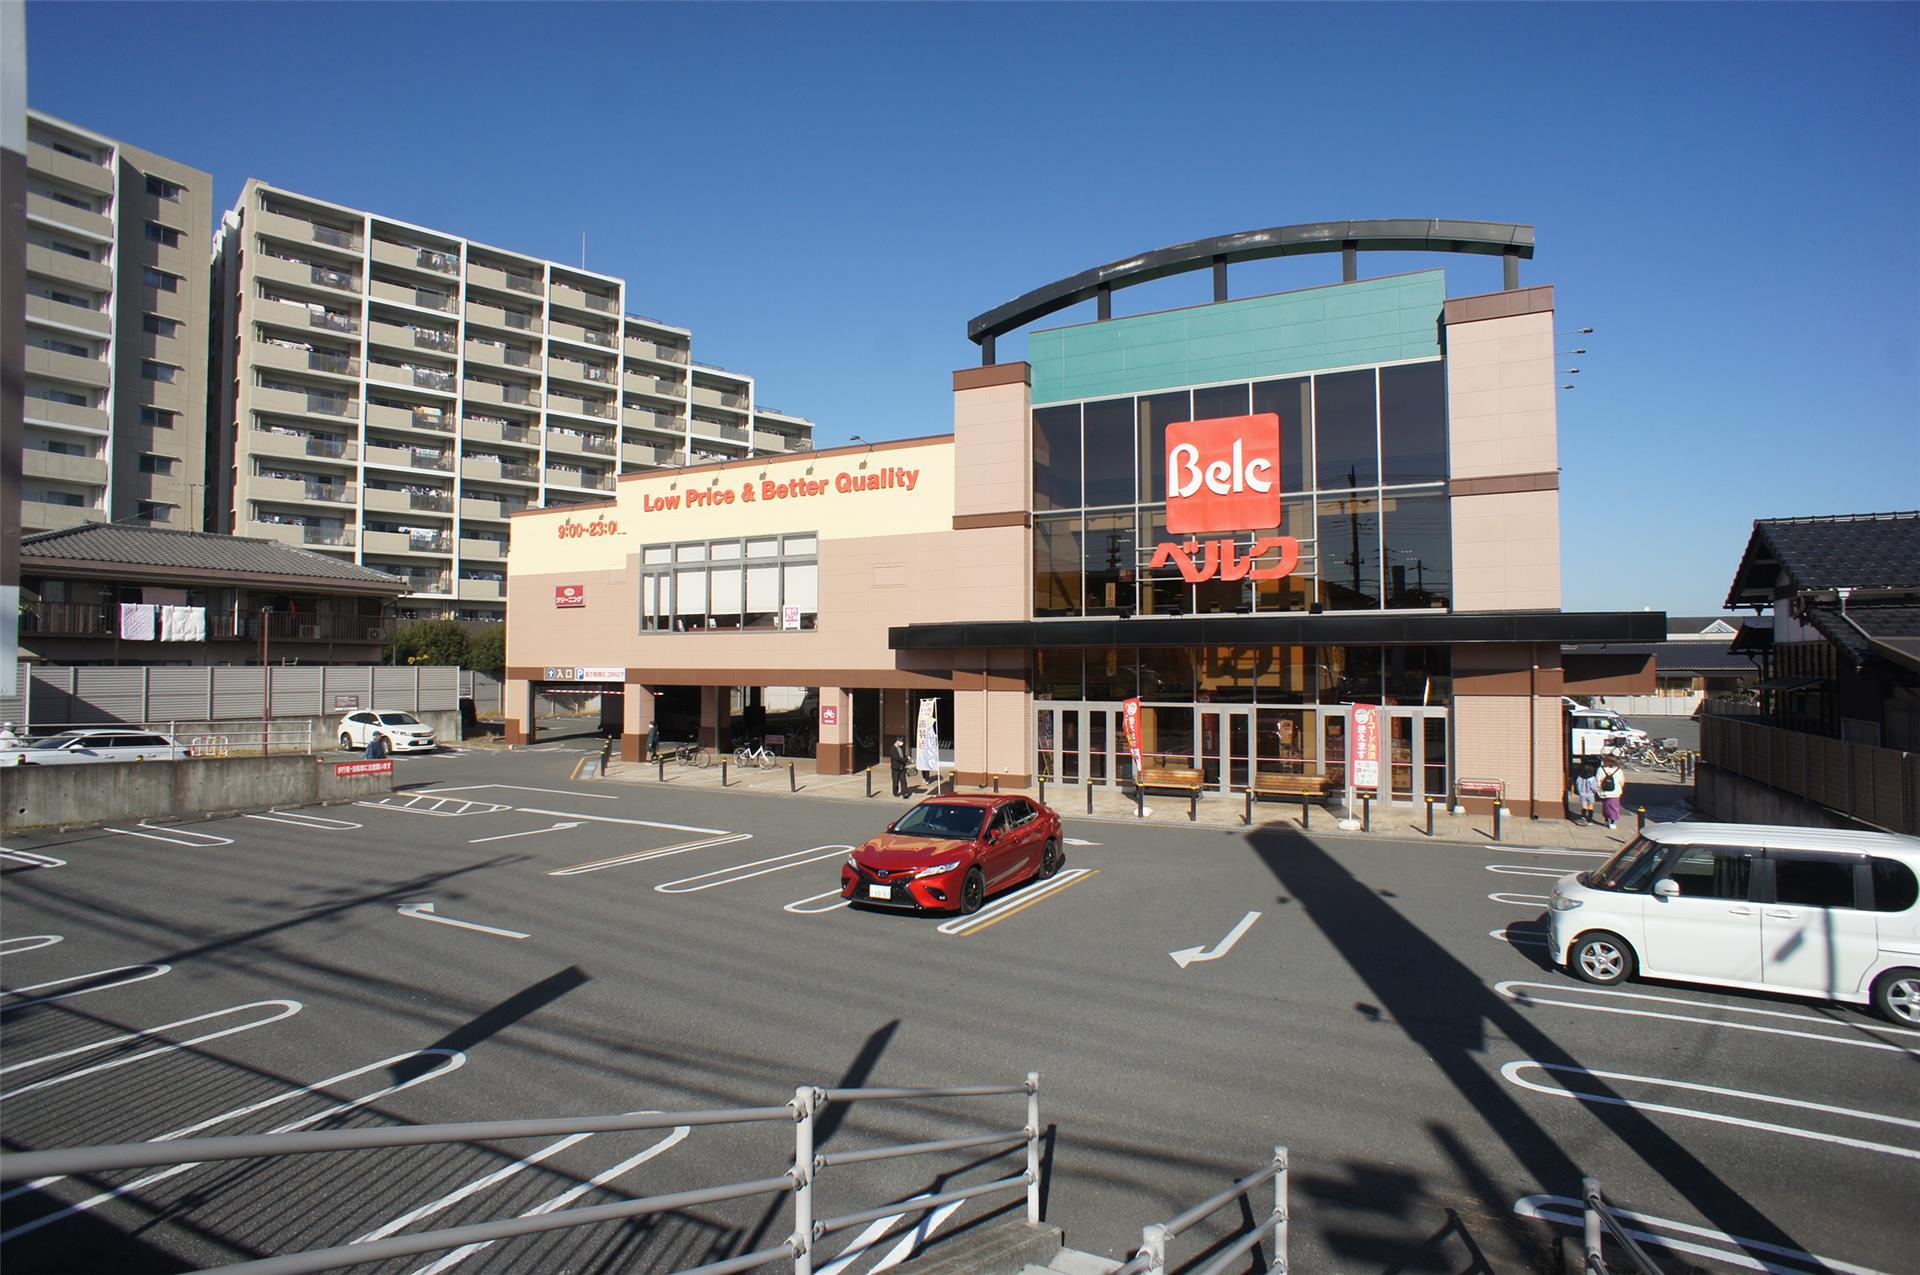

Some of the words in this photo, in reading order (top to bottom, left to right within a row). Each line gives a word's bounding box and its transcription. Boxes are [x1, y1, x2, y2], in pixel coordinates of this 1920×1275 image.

[643, 493, 681, 512] Low
[686, 487, 735, 508] Price
[741, 482, 755, 502] &
[761, 478, 829, 501] Better
[836, 466, 920, 494] Quality
[1168, 437, 1272, 498] Belc
[1149, 536, 1300, 584] ベルク
[556, 595, 583, 604] クリーニング
[556, 668, 573, 679] 入口
